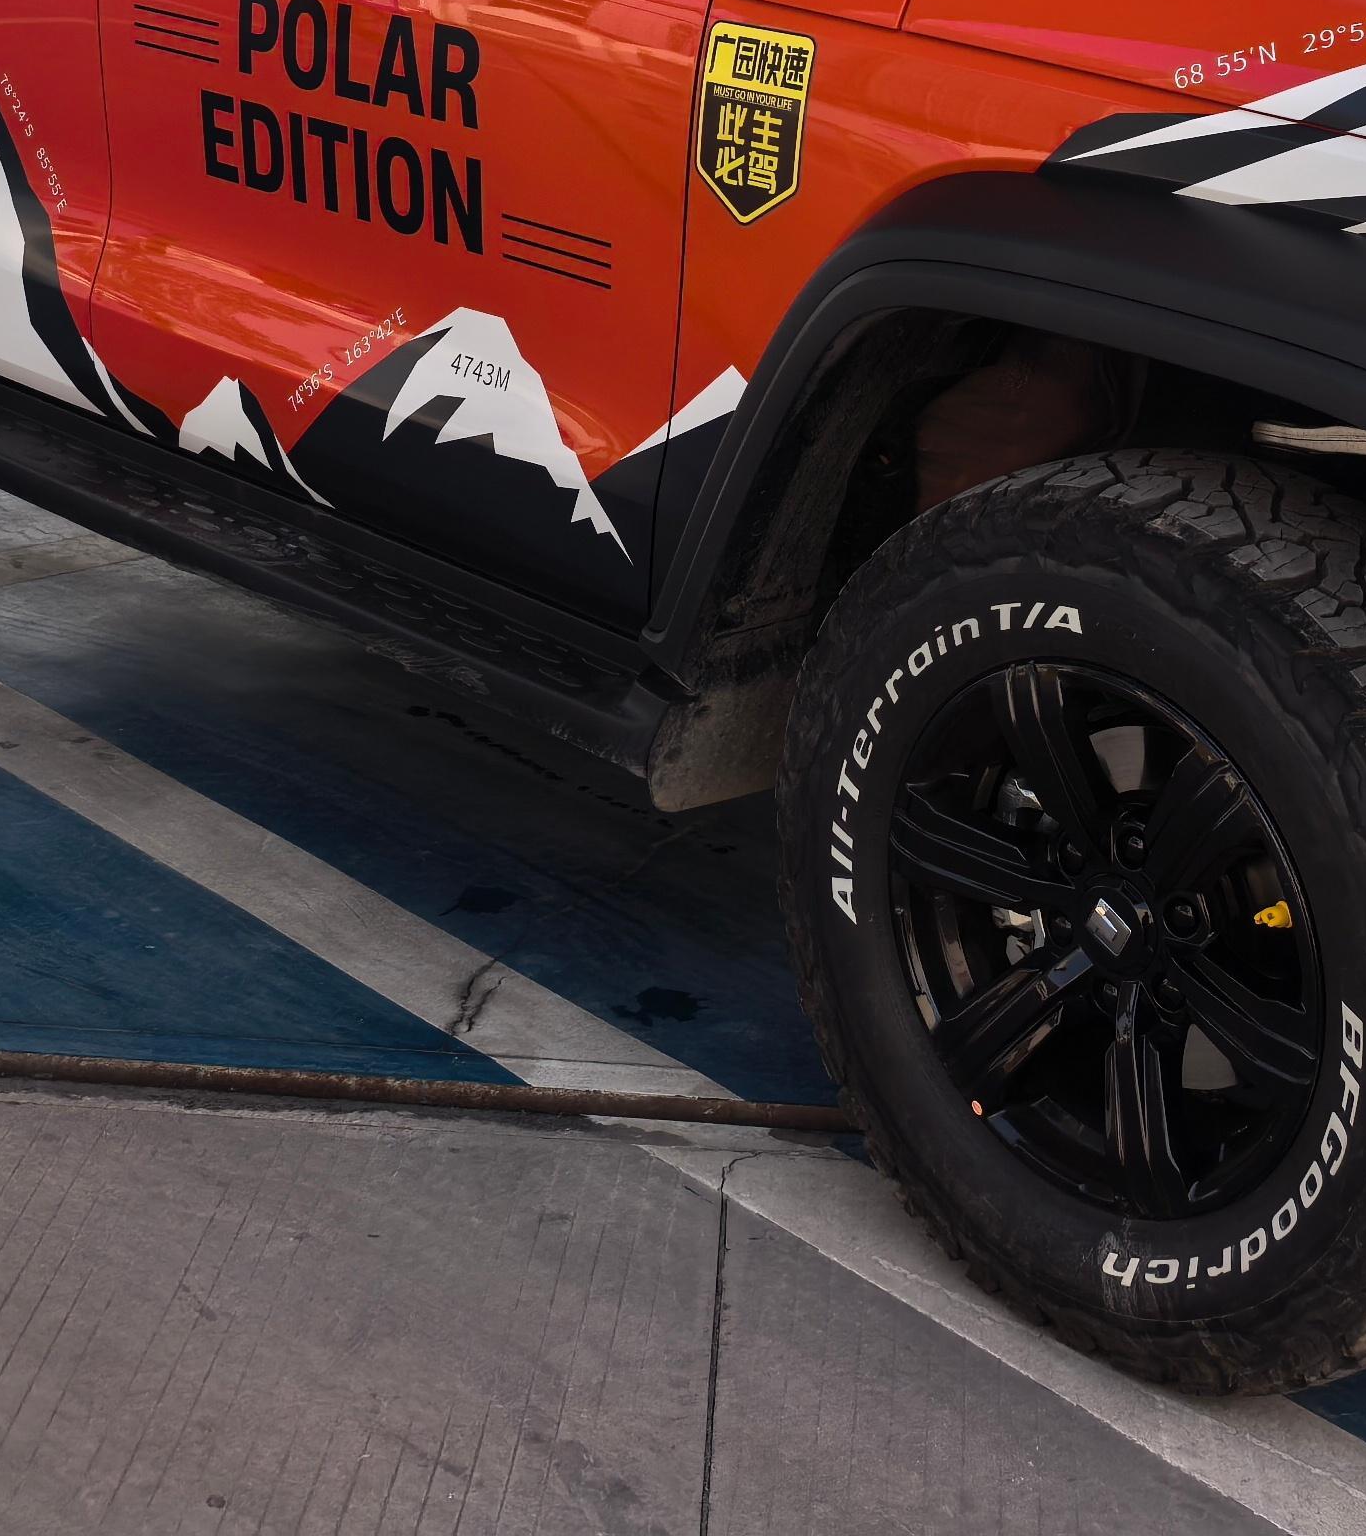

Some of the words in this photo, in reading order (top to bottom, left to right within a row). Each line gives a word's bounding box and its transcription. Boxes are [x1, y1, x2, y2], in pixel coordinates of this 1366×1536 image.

[708, 33, 810, 92] 广园快速
[713, 84, 735, 97] MUST
[734, 88, 747, 101] GO
[746, 91, 756, 103] IN
[755, 93, 778, 107] YOUR
[776, 97, 793, 111] LIFE
[0, 73, 34, 137] 78°24'S
[36, 147, 68, 213] 85°55'E
[716, 102, 783, 153] 此生
[201, 89, 484, 256] EDITION
[714, 146, 779, 195] 必驾
[287, 363, 333, 412] 74°56'S
[344, 307, 407, 367] 163°42'E
[450, 353, 512, 393] 4743M
[831, 617, 980, 925] All-Terrain
[990, 602, 1083, 634] T/A
[1102, 1000, 1364, 1289] BFGoodrich
